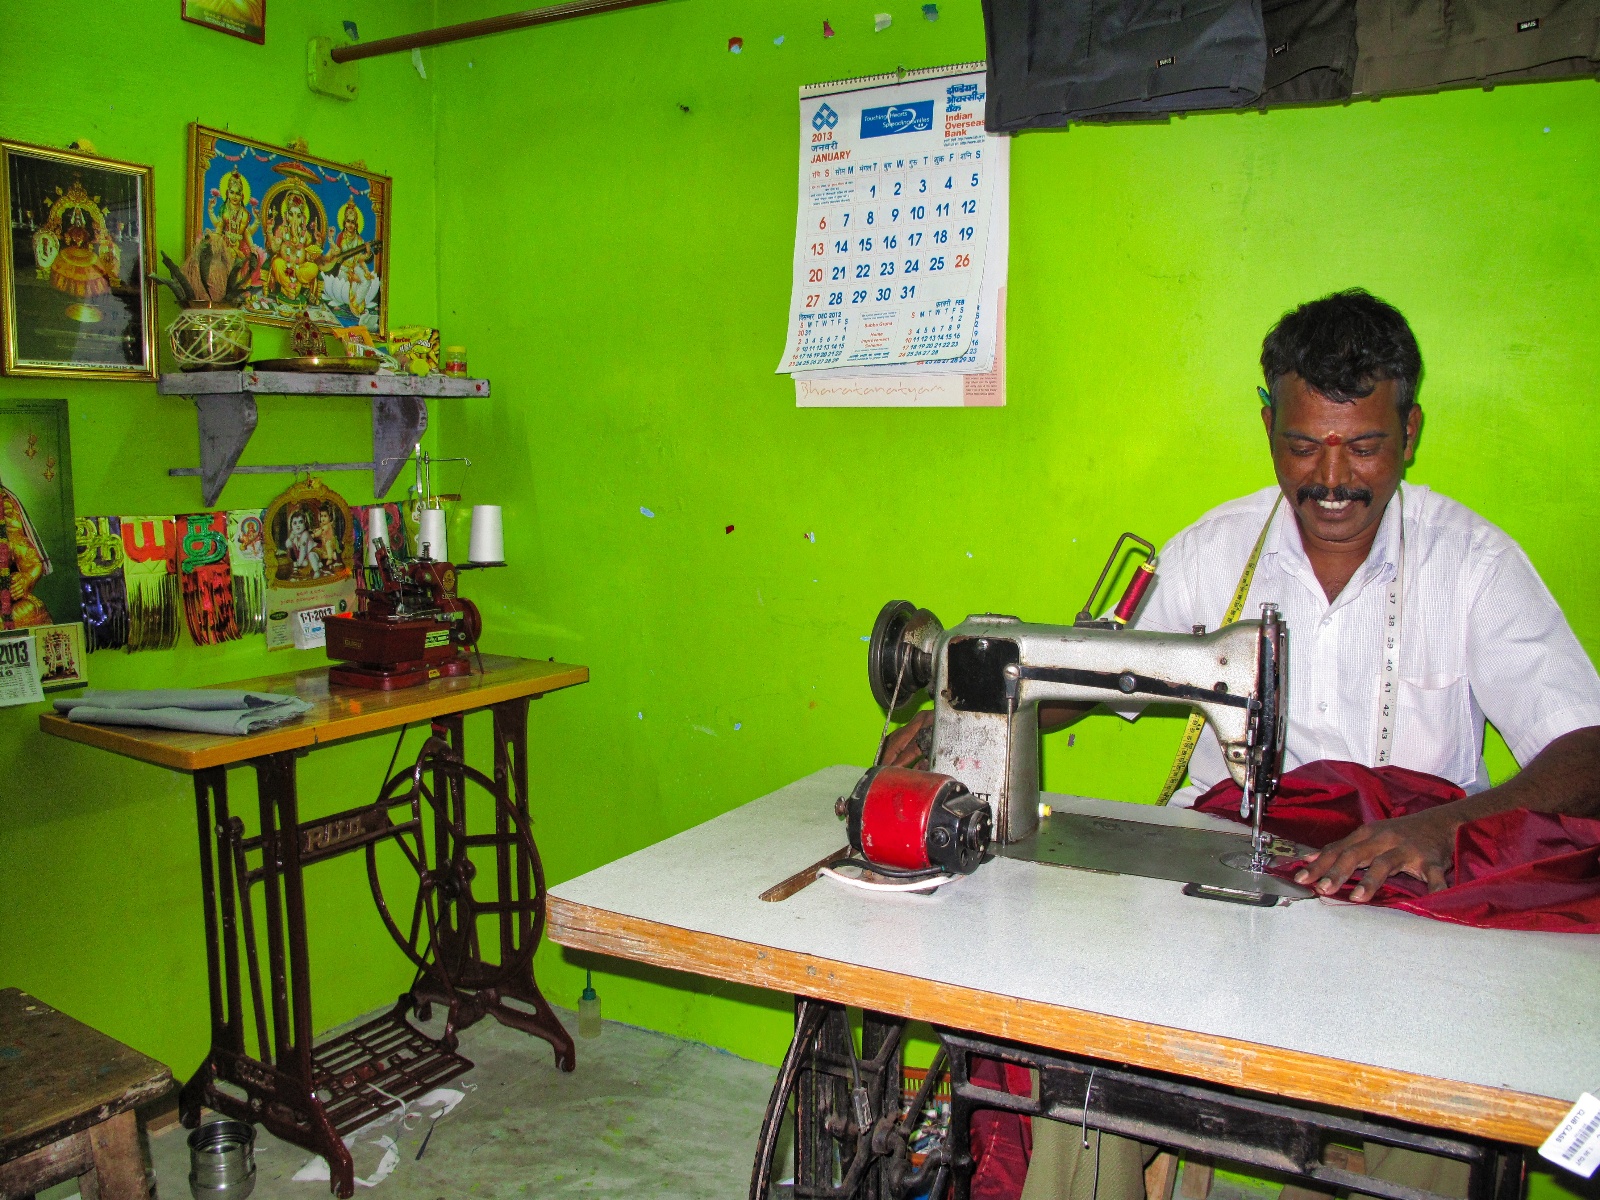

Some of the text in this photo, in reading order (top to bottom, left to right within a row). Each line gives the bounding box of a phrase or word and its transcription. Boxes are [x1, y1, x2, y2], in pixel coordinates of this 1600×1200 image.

[946, 113, 972, 121] Indian
[945, 120, 986, 129] Overseas
[812, 132, 832, 142] 2013
[945, 129, 967, 138] Bank
[811, 141, 838, 152] जनवरी
[811, 150, 851, 163] JANUARY
[825, 169, 829, 177] S
[848, 166, 853, 174] M
[873, 163, 877, 171] T
[897, 160, 903, 168] W
[924, 157, 928, 165] T
[950, 153, 954, 161] F
[870, 173, 978, 198] 1 2 3 4 5
[819, 200, 976, 230] 6 7 8 9 10 11 12
[811, 227, 973, 256] 13 14 15 16 17 18 19
[809, 254, 969, 282] 20 21 22 23 24 25 26
[806, 286, 915, 307] 27 28 29 30 31
[1388, 614, 1395, 627] 38
[1382, 704, 1389, 717] 42
[1570, 1109, 1585, 1125] CLUB
[1556, 1124, 1573, 1143] CLASS
